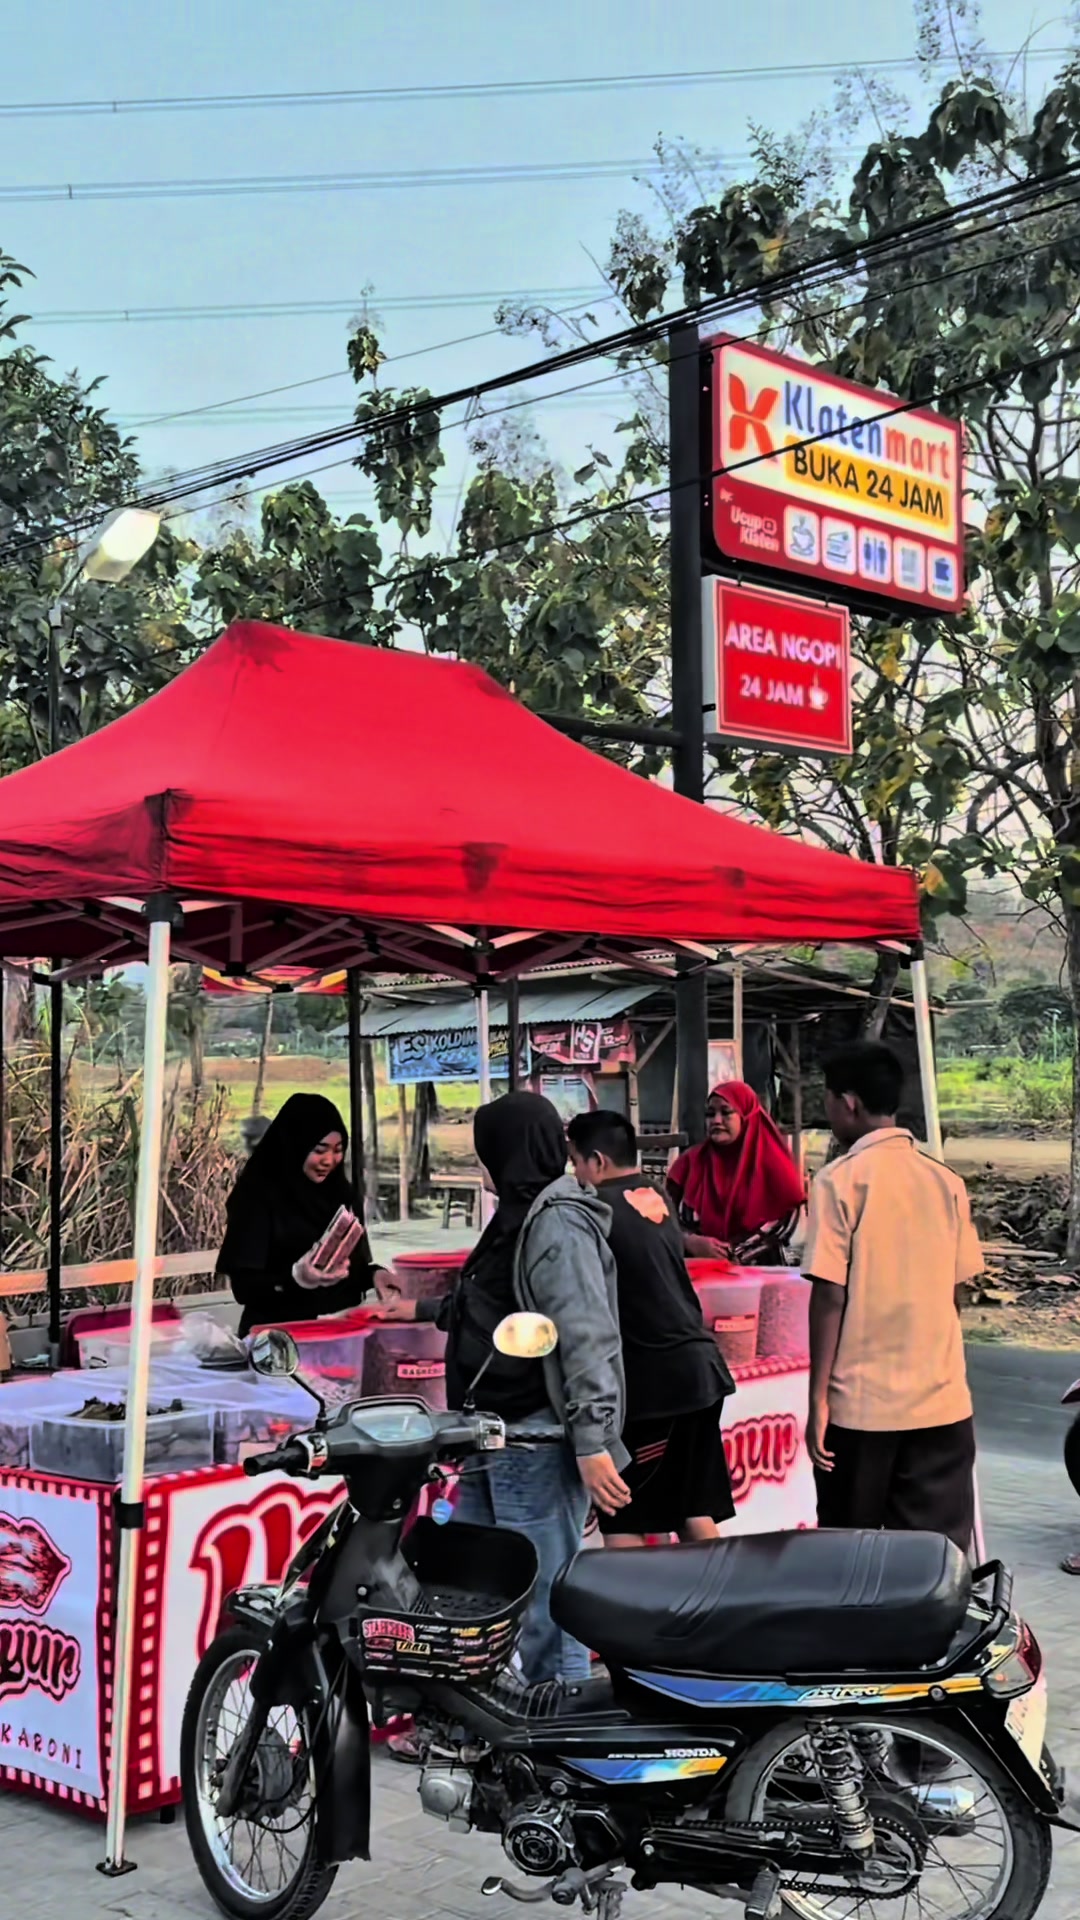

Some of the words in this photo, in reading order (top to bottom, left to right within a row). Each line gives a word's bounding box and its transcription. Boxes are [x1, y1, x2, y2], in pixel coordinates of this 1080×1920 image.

[793, 447, 860, 493] BUKA
[866, 469, 894, 503] 24
[900, 478, 944, 520] JAM
[725, 620, 779, 657] AREA
[781, 632, 843, 670] NGOPI
[740, 673, 762, 699] 24
[766, 679, 804, 706] JAM
[399, 1034, 428, 1063] ES
[664, 1748, 721, 1758] HONDA
